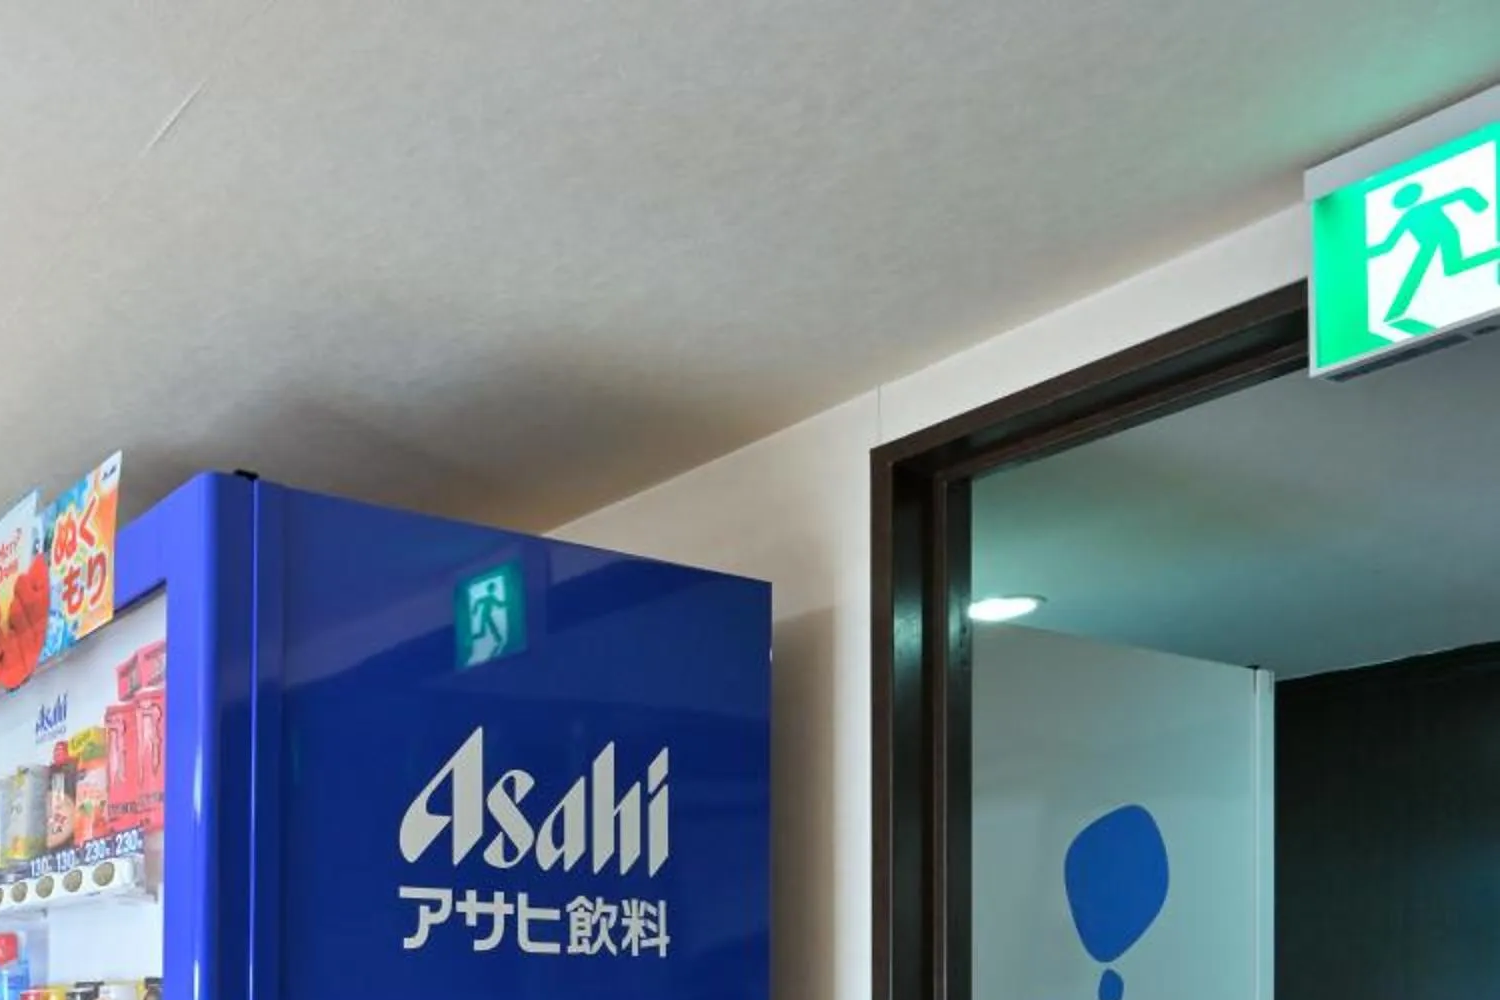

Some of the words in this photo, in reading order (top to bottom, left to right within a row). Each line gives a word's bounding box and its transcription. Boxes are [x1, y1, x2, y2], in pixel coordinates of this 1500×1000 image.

[53, 495, 97, 566] ぬく
[61, 551, 107, 616] もり
[36, 692, 68, 735] Asahi
[400, 726, 669, 878] Asahi
[400, 886, 670, 957] アサヒ飲料
